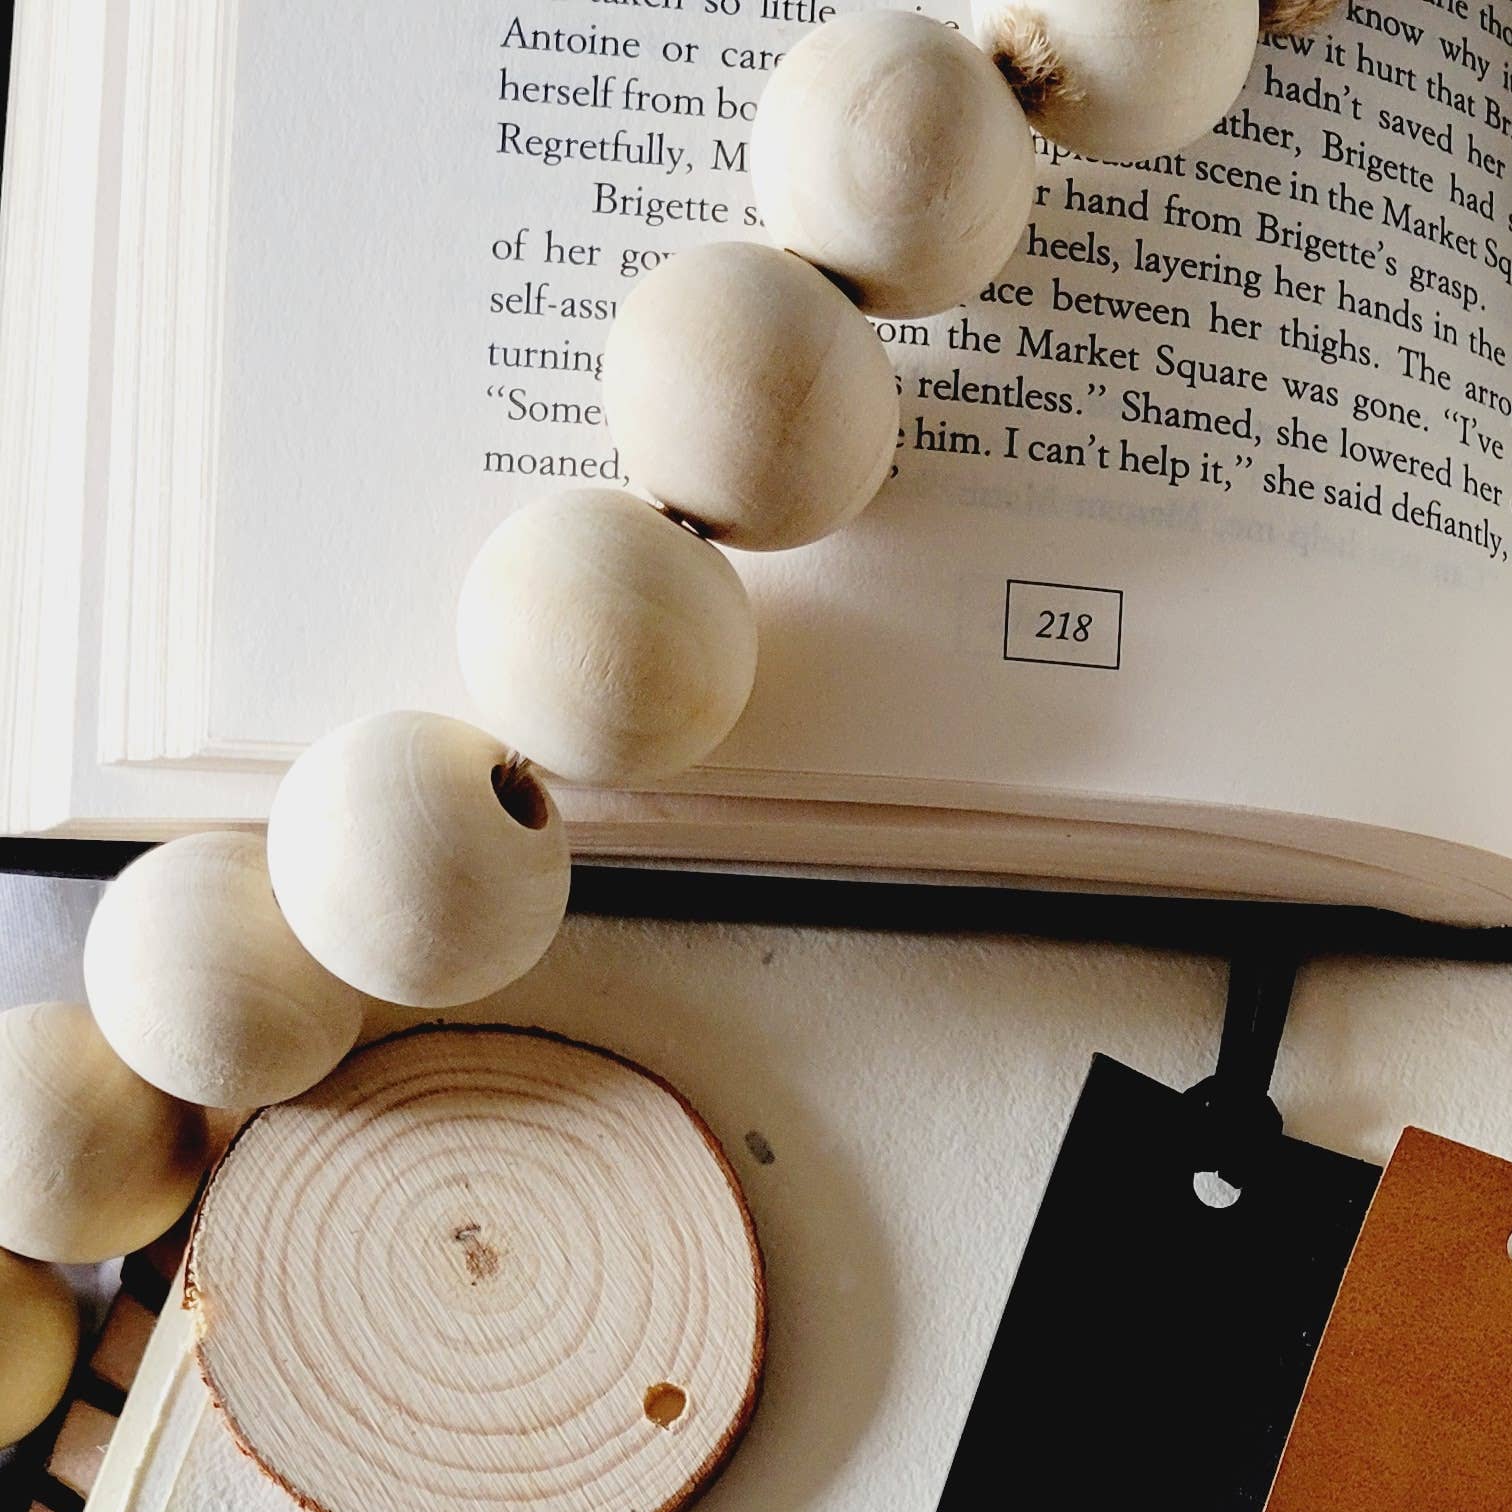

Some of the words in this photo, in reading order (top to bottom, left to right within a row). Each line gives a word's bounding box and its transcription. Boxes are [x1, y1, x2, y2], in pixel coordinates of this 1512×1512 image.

[1325, 35, 1346, 67] it
[1357, 42, 1416, 91] hurt
[1427, 72, 1475, 117] that
[1346, 0, 1424, 45] know
[1439, 37, 1490, 82] why
[499, 67, 616, 108] herself
[622, 77, 705, 116] from
[1195, 161, 1281, 196] scene
[1290, 171, 1318, 205] in
[1328, 182, 1373, 220] the
[1382, 196, 1477, 259] Market
[500, 16, 640, 58] Antoine
[662, 42, 699, 63] or
[1322, 130, 1433, 192] Brigette
[1450, 173, 1494, 221] had
[1379, 110, 1452, 154] saved
[1468, 133, 1505, 179] her
[497, 122, 693, 175] Regretfully,
[1064, 178, 1148, 221] hand
[1164, 194, 1241, 237] from
[1410, 266, 1485, 311] grasp.
[592, 182, 728, 226] Brigette
[1026, 223, 1119, 273] heels,
[1134, 238, 1262, 298] layering
[1274, 264, 1325, 305] her
[1338, 280, 1422, 332] hands
[1434, 312, 1457, 345] in
[1469, 327, 1505, 366] the
[492, 228, 529, 261] of
[544, 229, 601, 266] her
[1052, 277, 1190, 328] between
[1209, 301, 1262, 340] her
[1280, 317, 1378, 368] thighs.
[1398, 346, 1450, 390] The
[948, 318, 1001, 354] the
[1016, 326, 1139, 371] Market
[1156, 344, 1267, 391] Square
[1282, 377, 1338, 406] was
[1353, 394, 1428, 431] gone.
[484, 448, 629, 486] moaned,
[913, 416, 990, 456] him.
[1004, 427, 1019, 459] I
[1119, 439, 1190, 487] help
[1264, 464, 1314, 500] she
[1324, 482, 1382, 515] said
[1392, 492, 1507, 561] defiantly,
[1122, 390, 1261, 447] Shamed,
[1277, 416, 1327, 453] she
[1340, 427, 1451, 487] lowered
[1464, 464, 1502, 506] her
[1035, 610, 1092, 642] 218
